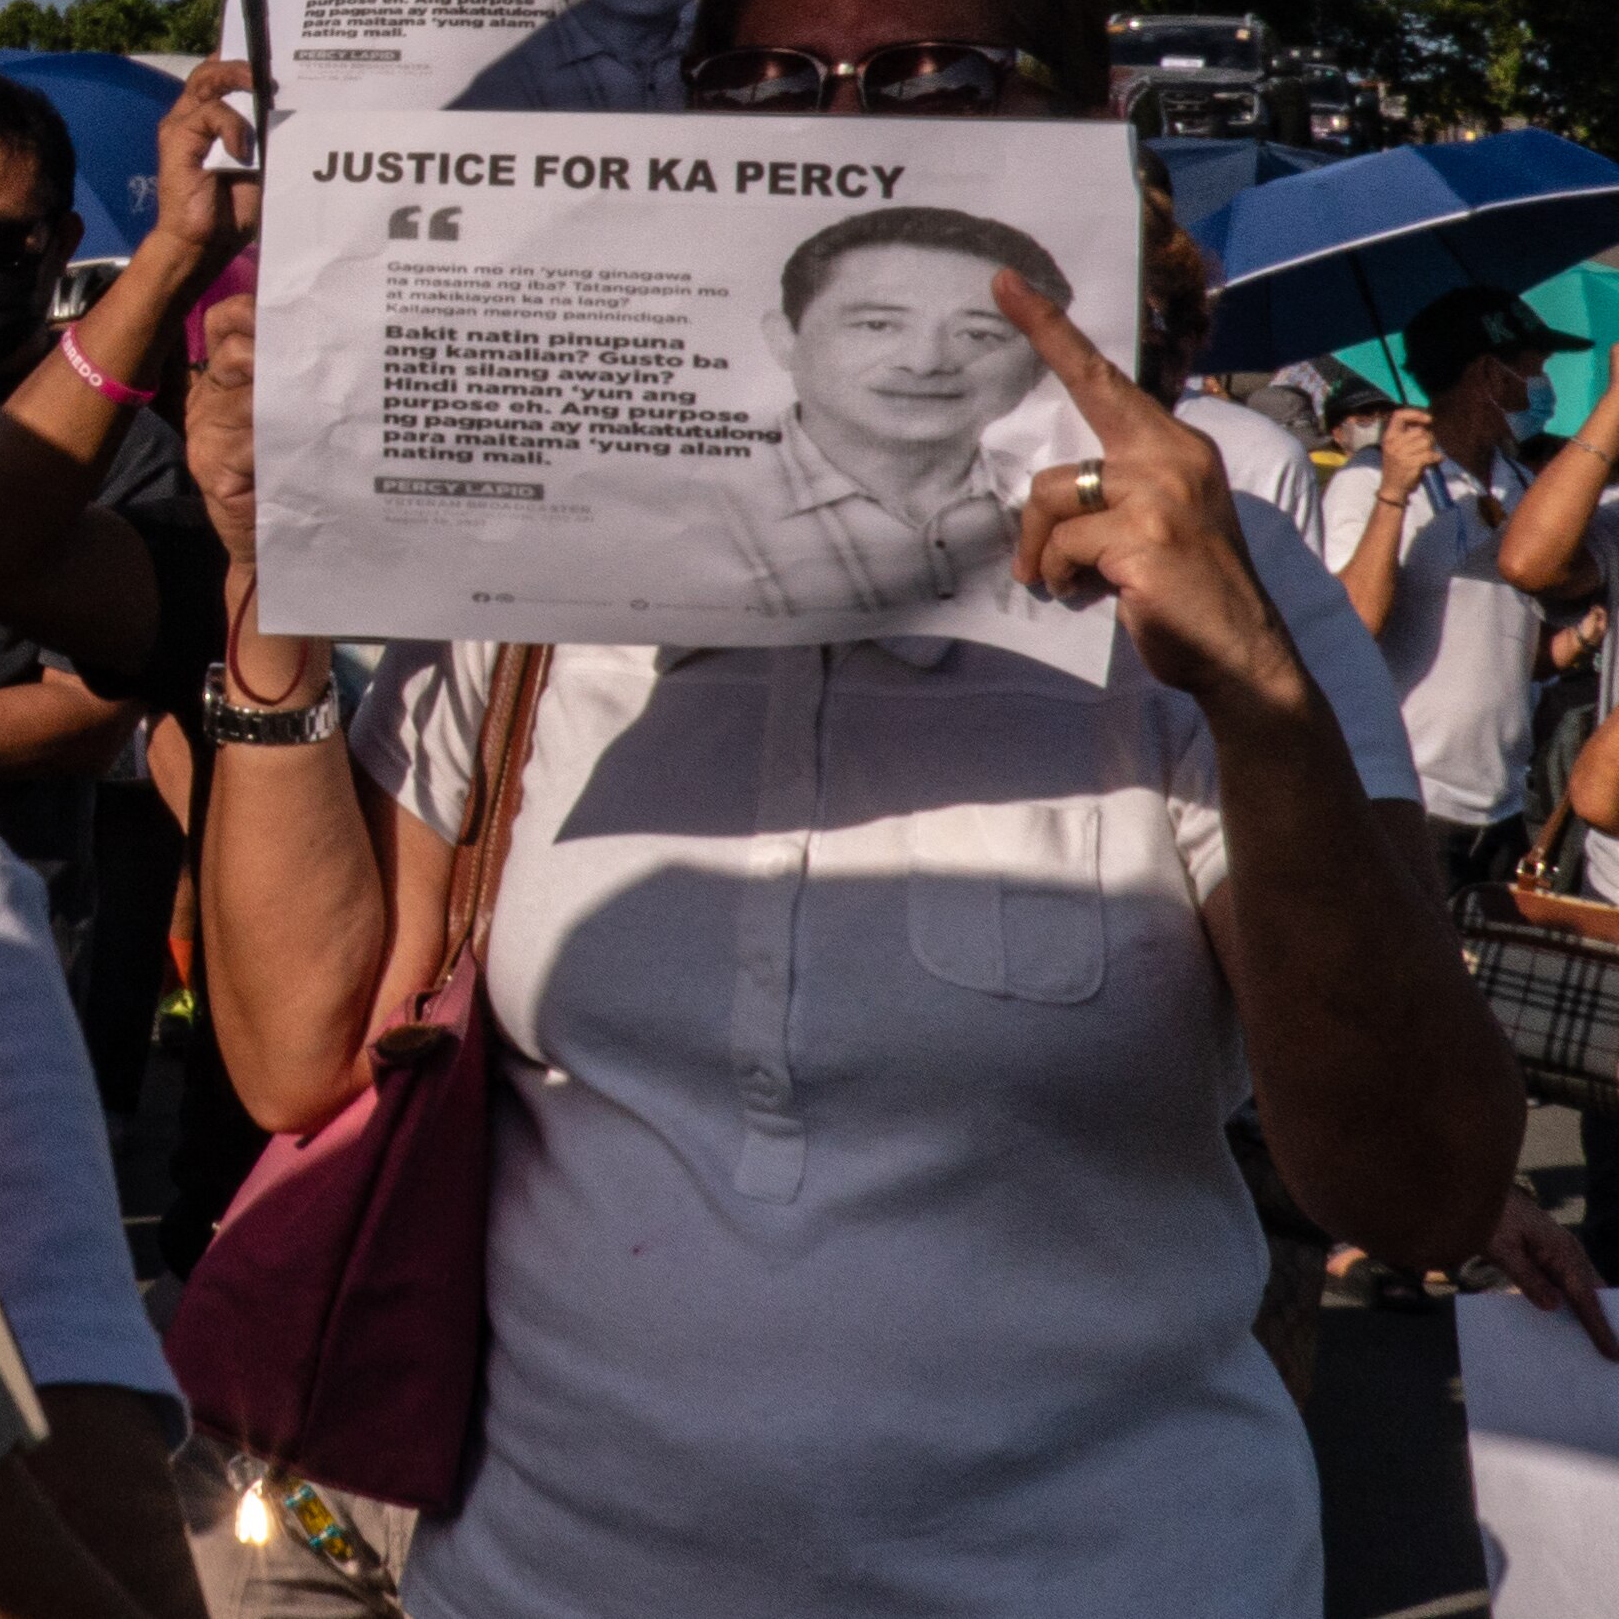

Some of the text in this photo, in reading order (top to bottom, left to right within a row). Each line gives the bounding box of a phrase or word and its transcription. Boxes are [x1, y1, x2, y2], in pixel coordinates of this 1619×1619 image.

[312, 151, 905, 199] JUSTICE FOR KA PERCY
[385, 325, 685, 350] Bakit natin pinupuna
[385, 344, 729, 370] ang kamalian? Gusto ba
[383, 361, 675, 385] natin silang awayin?
[383, 377, 458, 394] Hindi
[466, 382, 563, 397] naman
[642, 389, 697, 406] ang
[383, 396, 750, 423] purpose eh. Ang purpose
[383, 413, 783, 444] ng pagpuna ay makatutulong
[383, 430, 446, 444] para
[455, 433, 580, 449] maitama
[680, 441, 752, 458] alam
[383, 446, 552, 466] nating mali.
